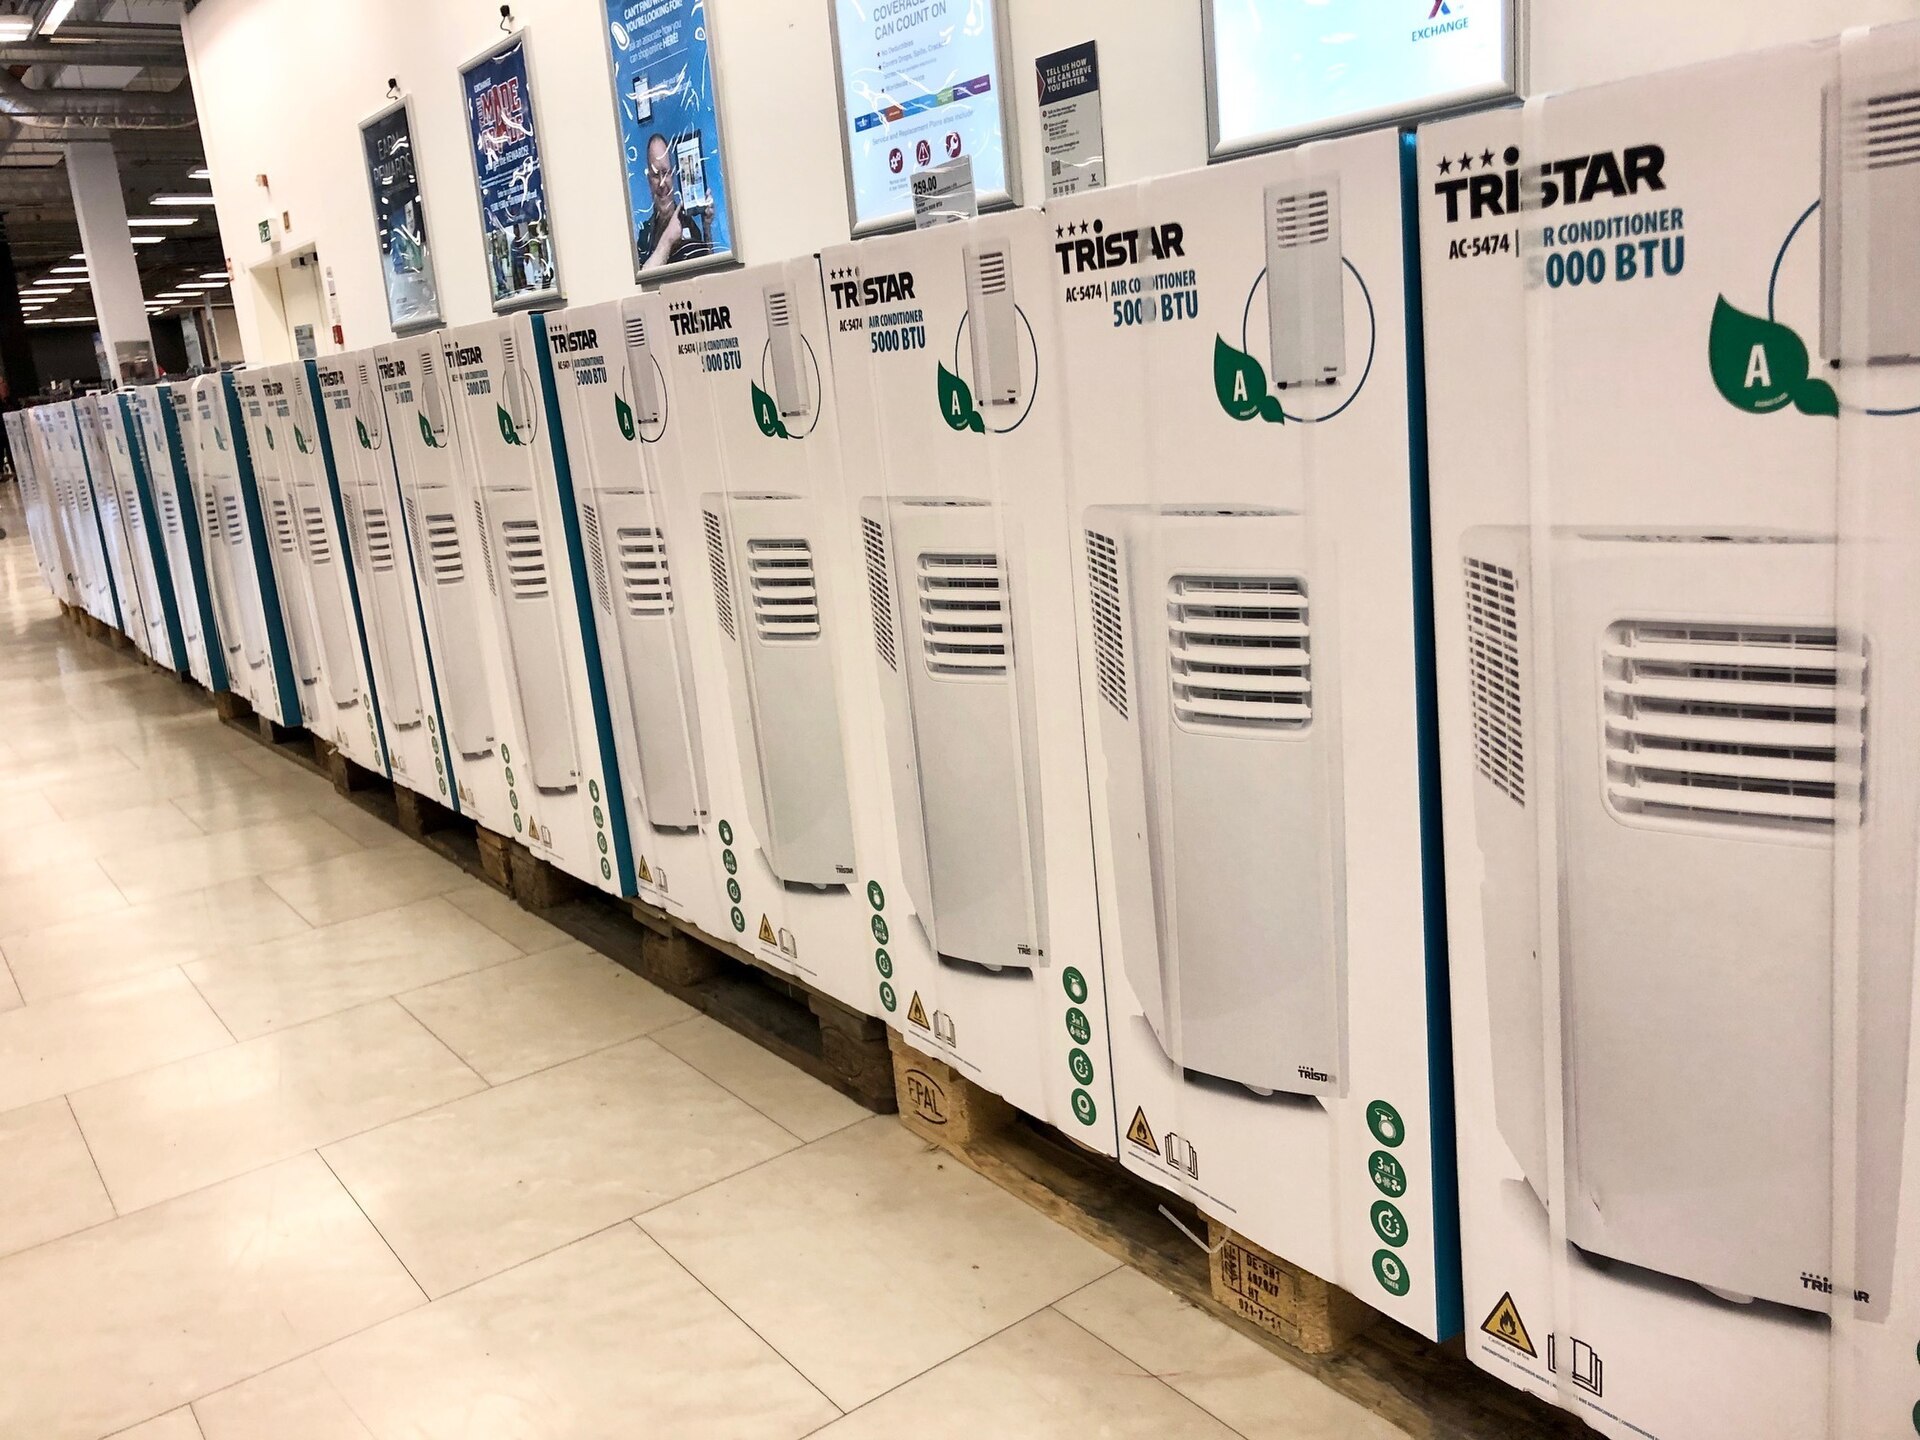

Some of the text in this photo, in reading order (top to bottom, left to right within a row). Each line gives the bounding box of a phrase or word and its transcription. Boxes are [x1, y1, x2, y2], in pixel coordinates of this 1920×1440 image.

[643, 5, 669, 24] LOOKING
[873, 0, 926, 22] COVERA
[875, 0, 946, 40] CAN COUNT ON
[1411, 17, 1469, 42] EXCHANGE
[1046, 57, 1087, 77] TELL US HOW
[1047, 65, 1091, 85] WE CAN SERVE
[1048, 82, 1061, 93] YOU
[914, 176, 937, 195] 259.00
[1449, 233, 1510, 260] AC-5474
[1557, 207, 1684, 246] CONDITIONER
[1615, 235, 1686, 282] BTU
[1066, 269, 1196, 303] AC-5474 AIR COITIONER
[1161, 290, 1198, 322] BTU
[840, 309, 924, 333] AC-5474 AIR CONDITIONER
[707, 337, 739, 351] CONDITIONER
[871, 325, 926, 353] 5000 BTU
[723, 350, 742, 371] BTU
[1744, 344, 1772, 388] A
[576, 366, 607, 386] 5000 BTU
[1233, 370, 1248, 402] A
[762, 403, 771, 425] A
[951, 390, 961, 415] A
[624, 412, 630, 430] A
[908, 1076, 944, 1118] EPAL
[1385, 1218, 1392, 1232] 2
